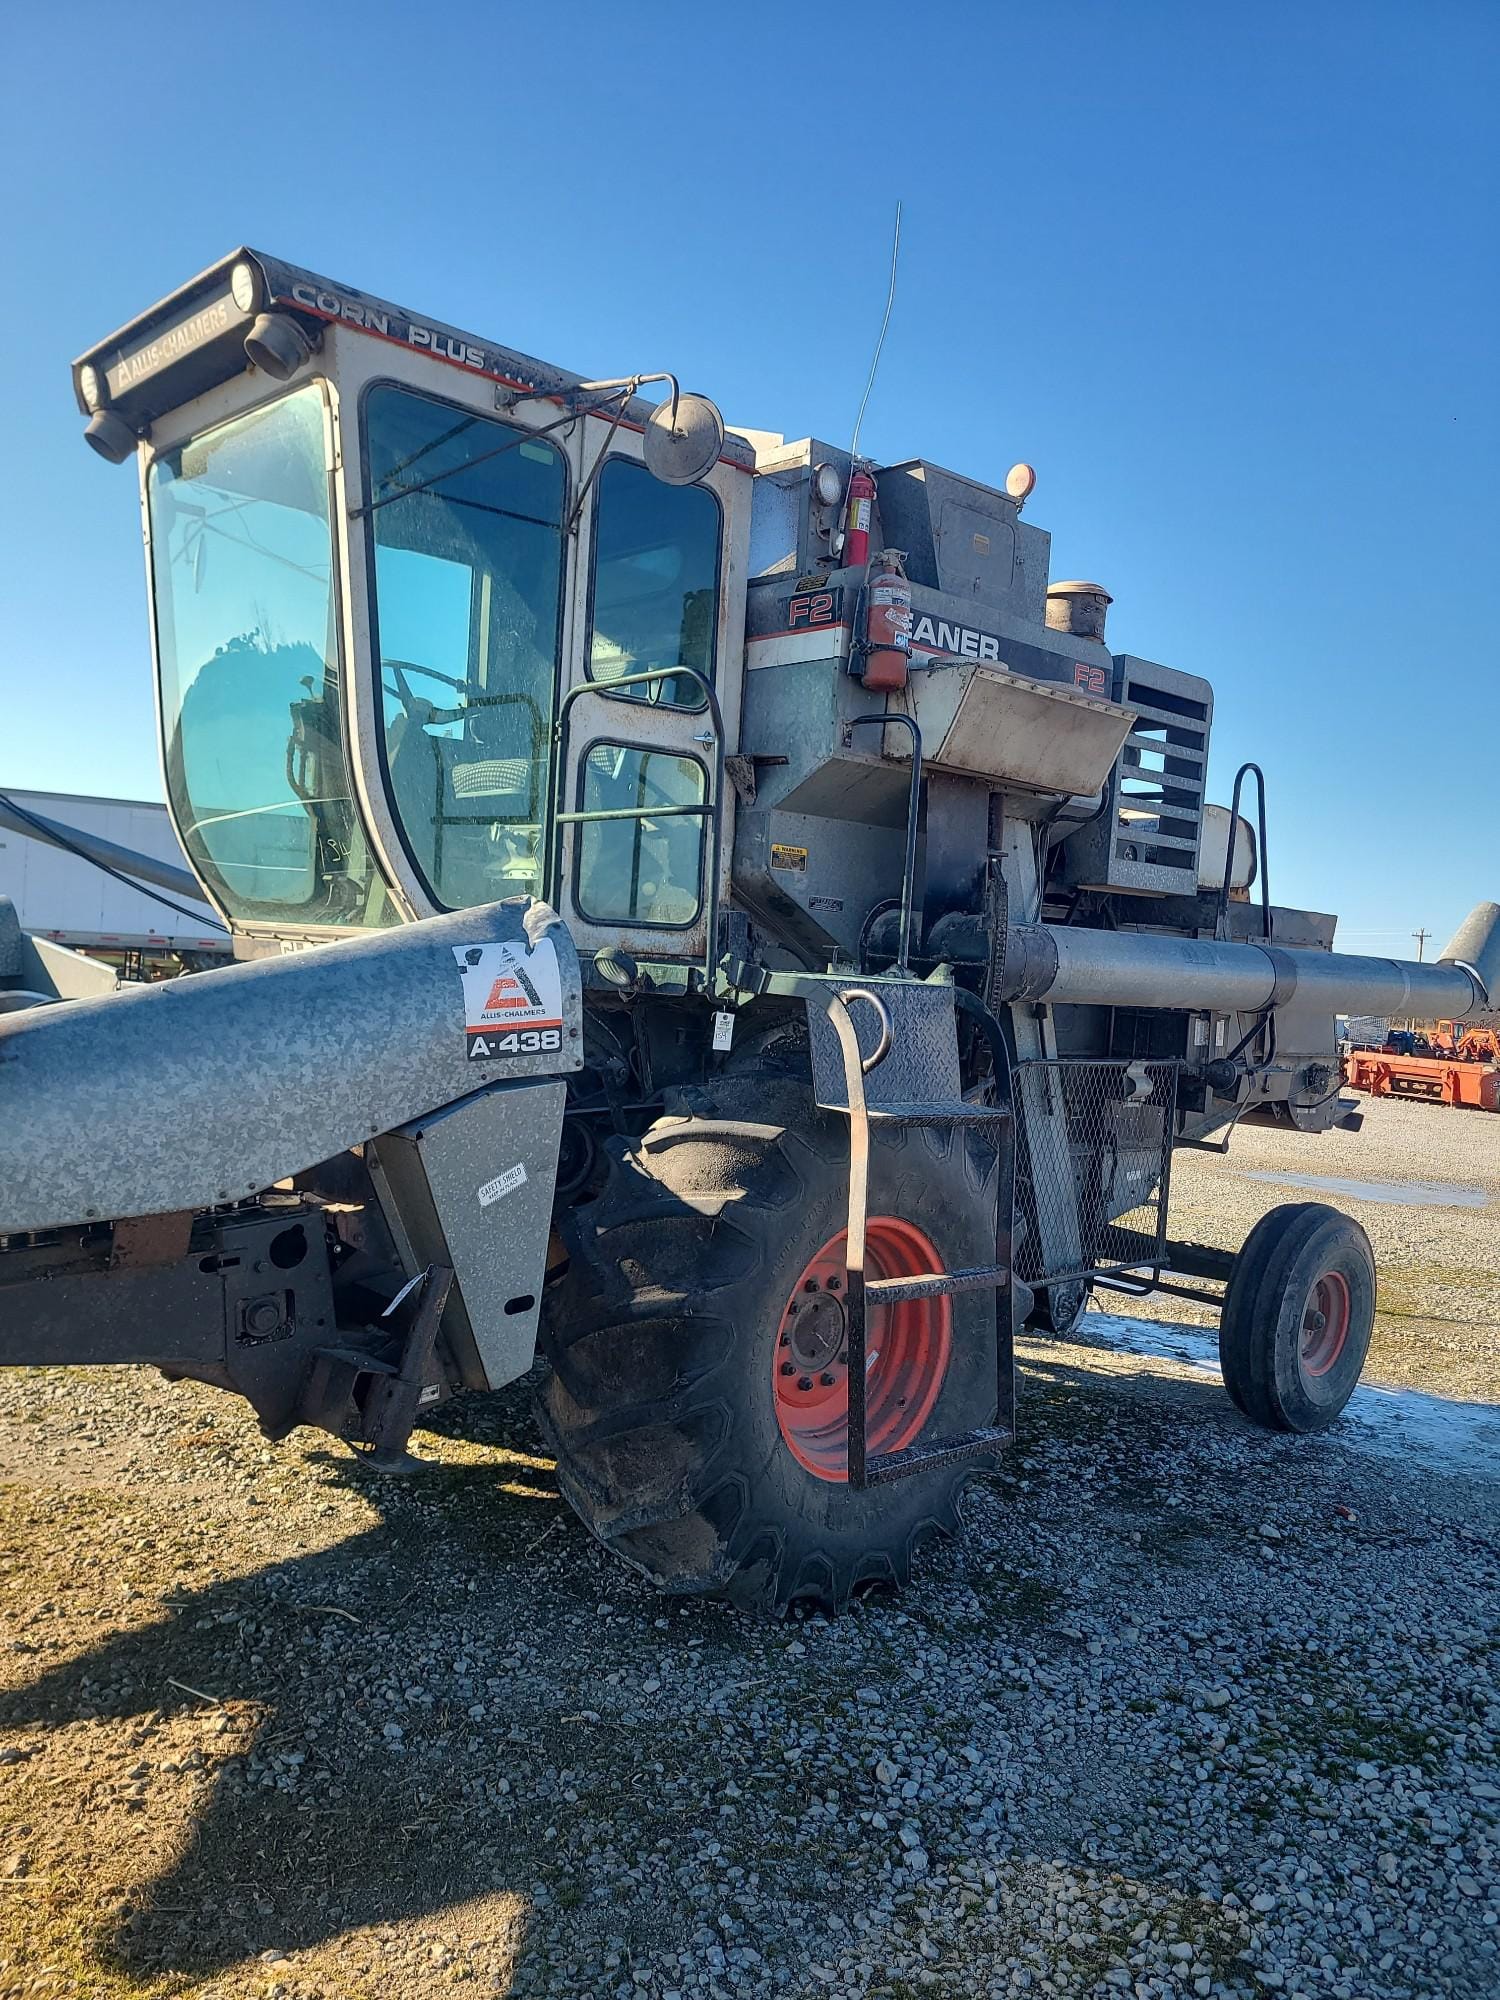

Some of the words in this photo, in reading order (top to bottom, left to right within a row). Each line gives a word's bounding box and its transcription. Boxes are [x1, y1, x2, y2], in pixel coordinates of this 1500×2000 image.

[132, 303, 228, 379] ALLIS-CHALMERS
[292, 283, 388, 334] CORN
[408, 325, 485, 369] PLUS
[789, 594, 833, 626] F2
[1074, 663, 1105, 693] F2
[781, 846, 803, 854] WARNING
[480, 1009, 546, 1020] ALLIS-CHALMERS
[469, 1029, 560, 1058] A-438
[480, 1180, 501, 1198] SAFETY
[503, 1168, 522, 1184] SHIELD
